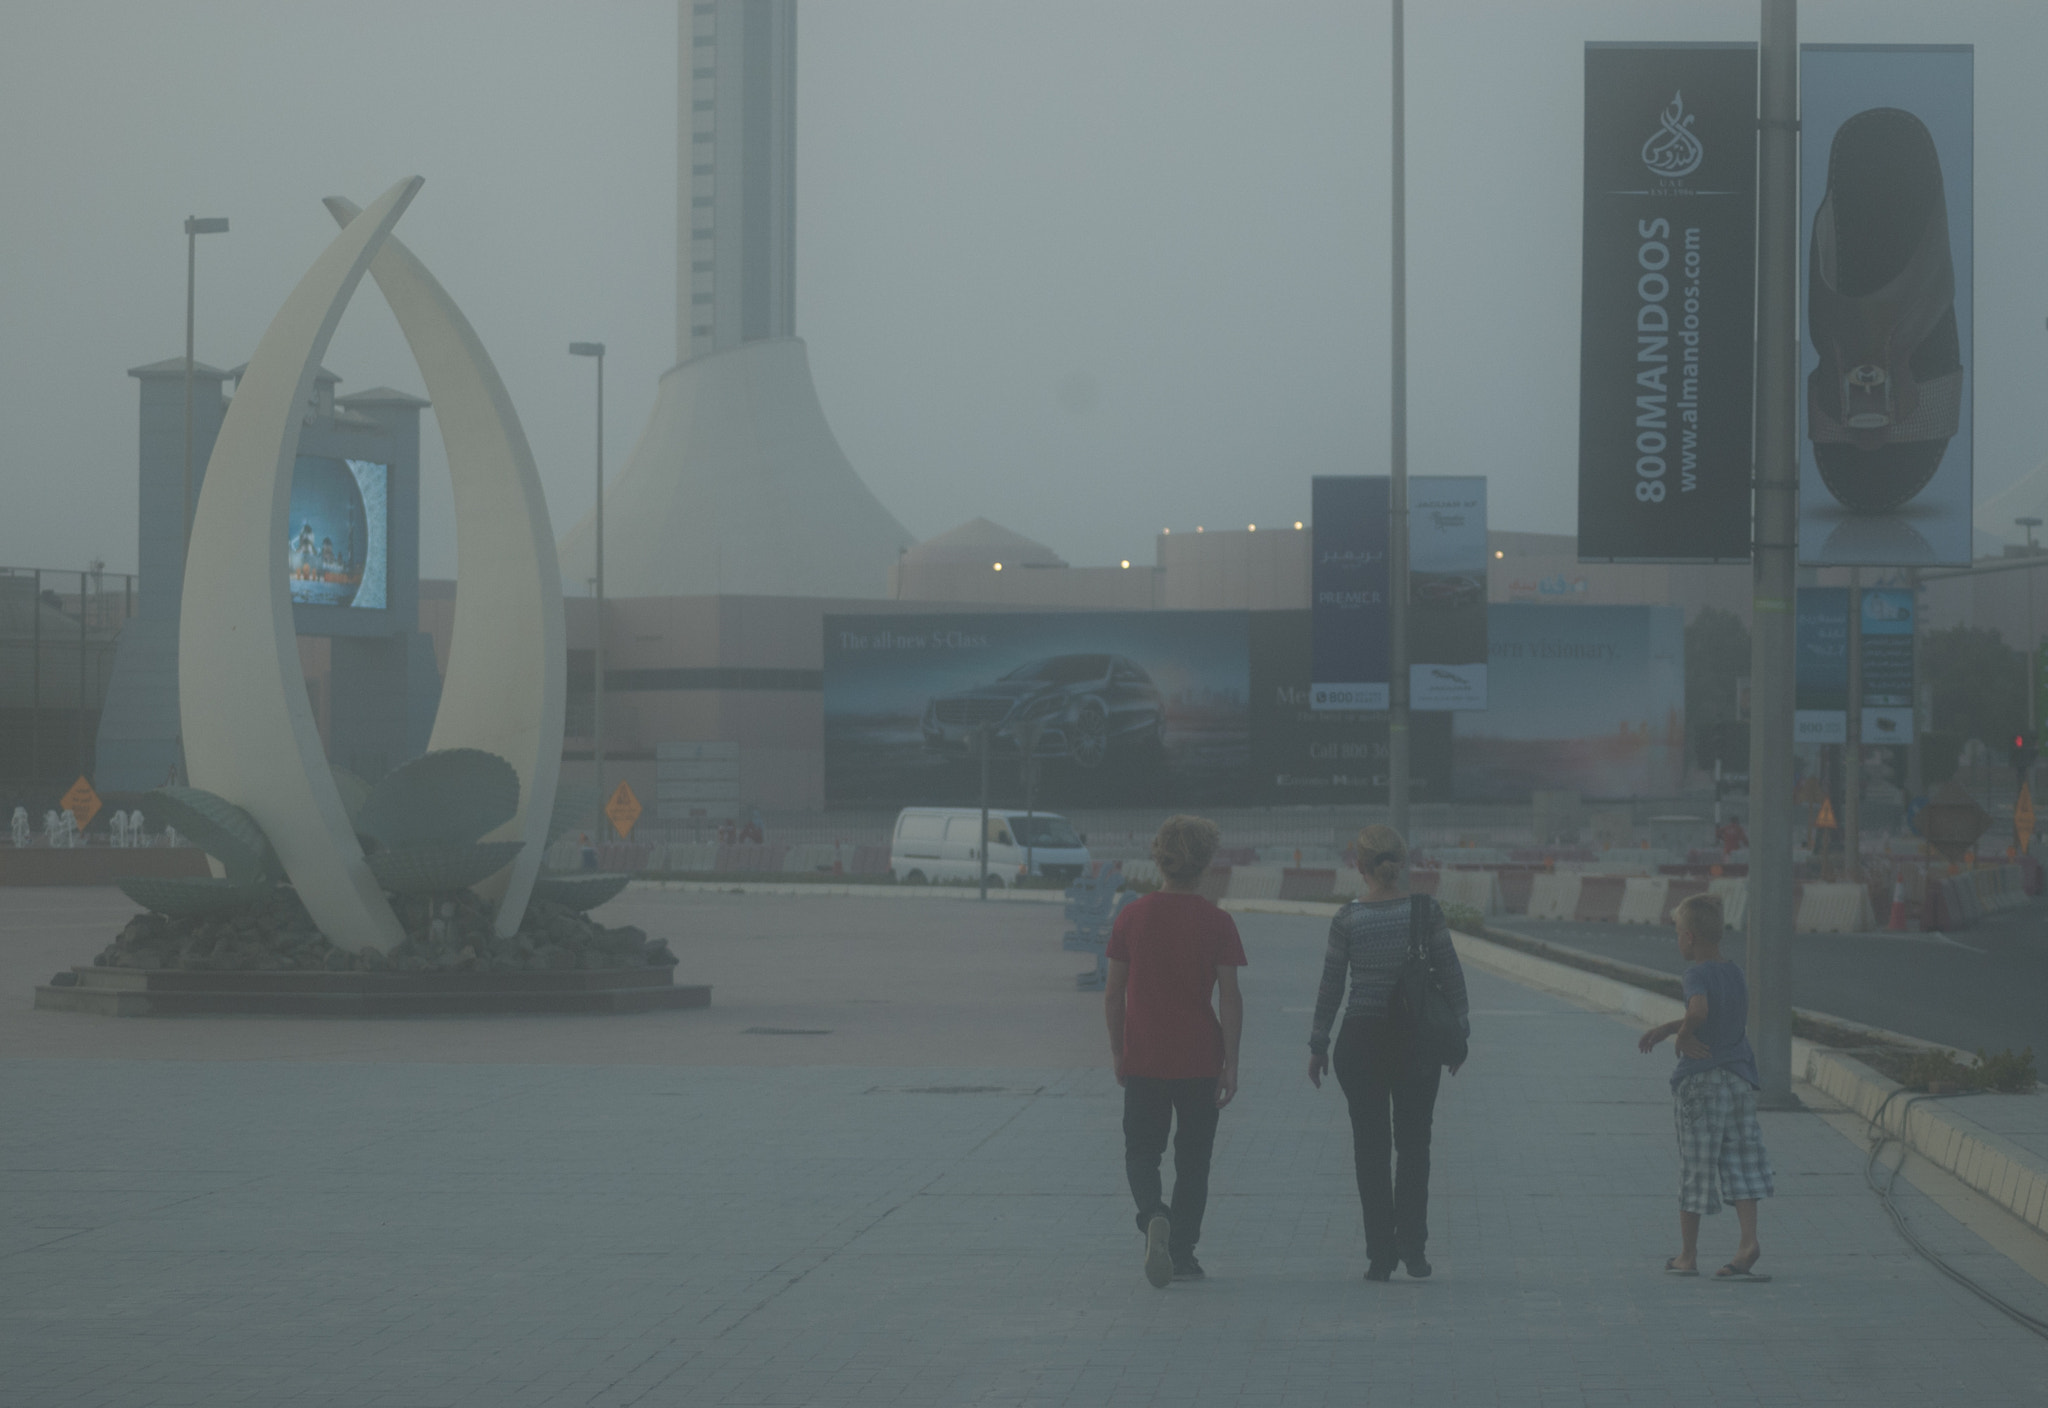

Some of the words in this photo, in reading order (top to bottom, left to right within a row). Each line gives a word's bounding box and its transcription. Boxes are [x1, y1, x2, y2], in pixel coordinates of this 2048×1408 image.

[1637, 218, 1669, 502] 800MANDOOS
[1677, 226, 1700, 493] www.almandoos.com
[1319, 592, 1381, 604] PREMIER
[839, 632, 869, 649] The
[873, 632, 927, 649] all-new
[1329, 691, 1353, 703] 800
[1310, 741, 1338, 759] Call
[1341, 742, 1368, 759] 800
